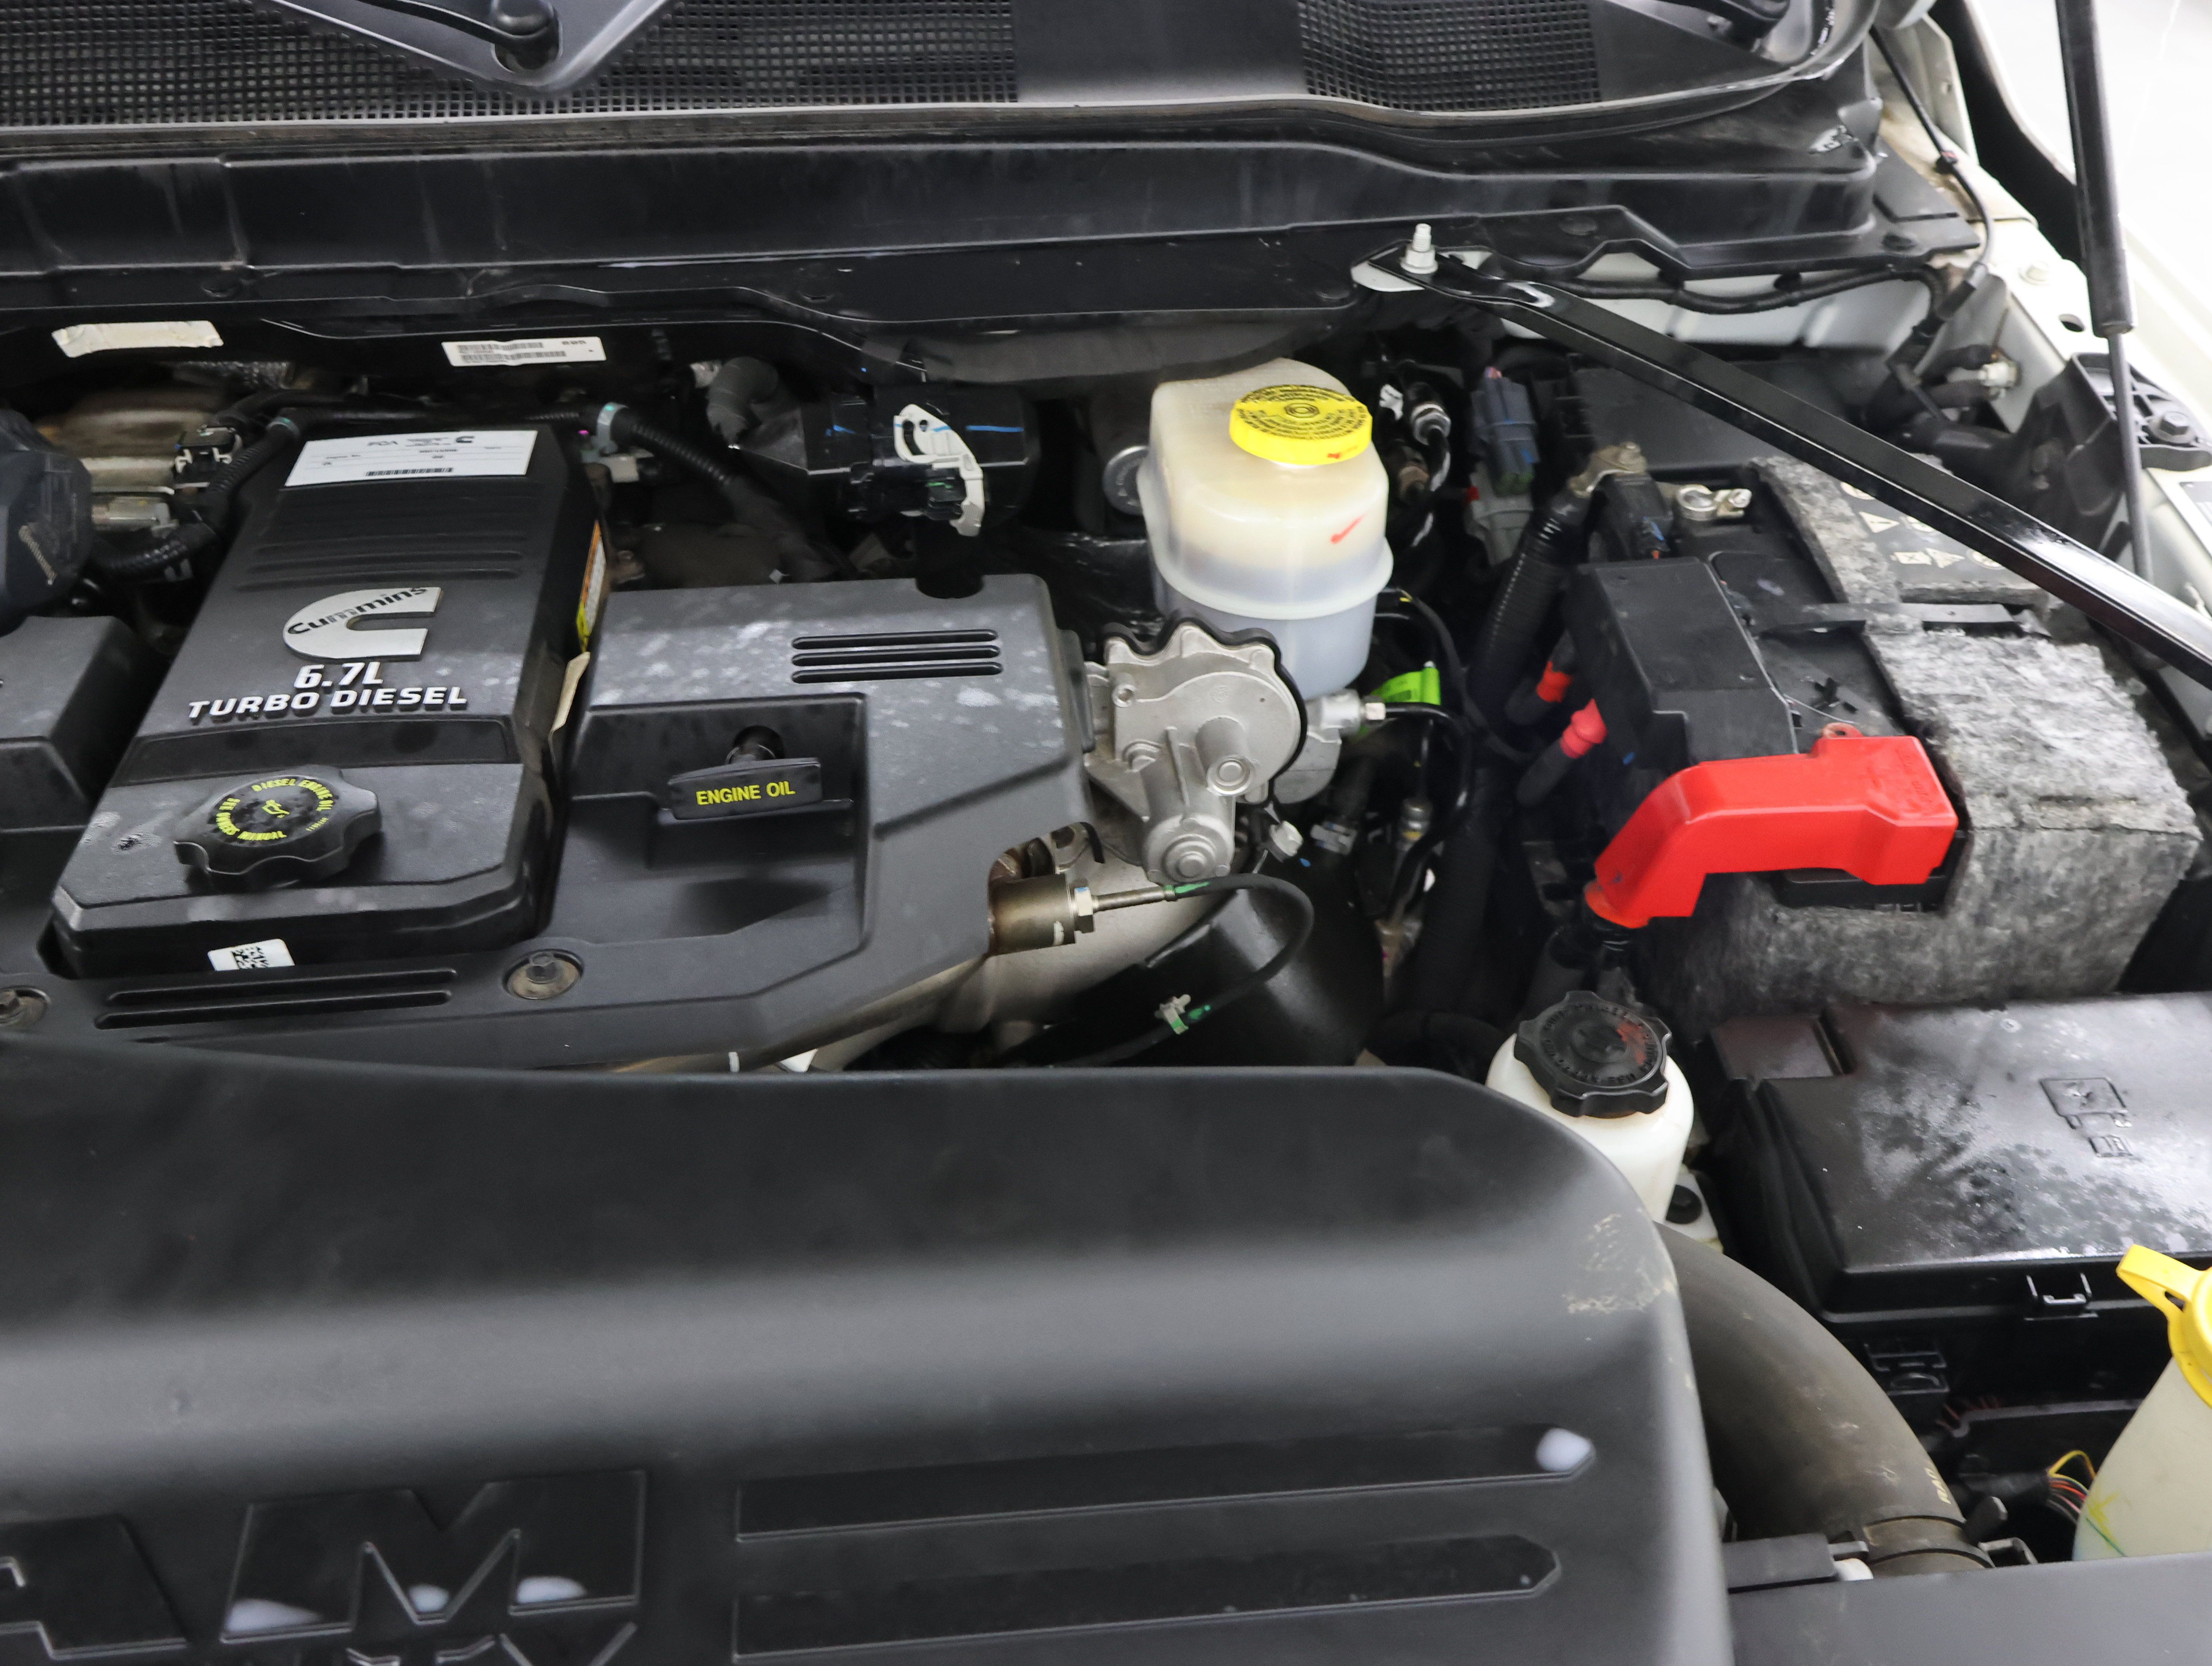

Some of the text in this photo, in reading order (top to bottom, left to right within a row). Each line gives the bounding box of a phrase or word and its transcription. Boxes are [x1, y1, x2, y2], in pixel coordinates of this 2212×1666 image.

[287, 587, 427, 635] Cummins
[293, 661, 384, 690] 6.7L
[188, 686, 467, 719] TURBO DIESEL
[251, 778, 297, 792] DIESEL
[695, 781, 796, 806] ENGINE OIL
